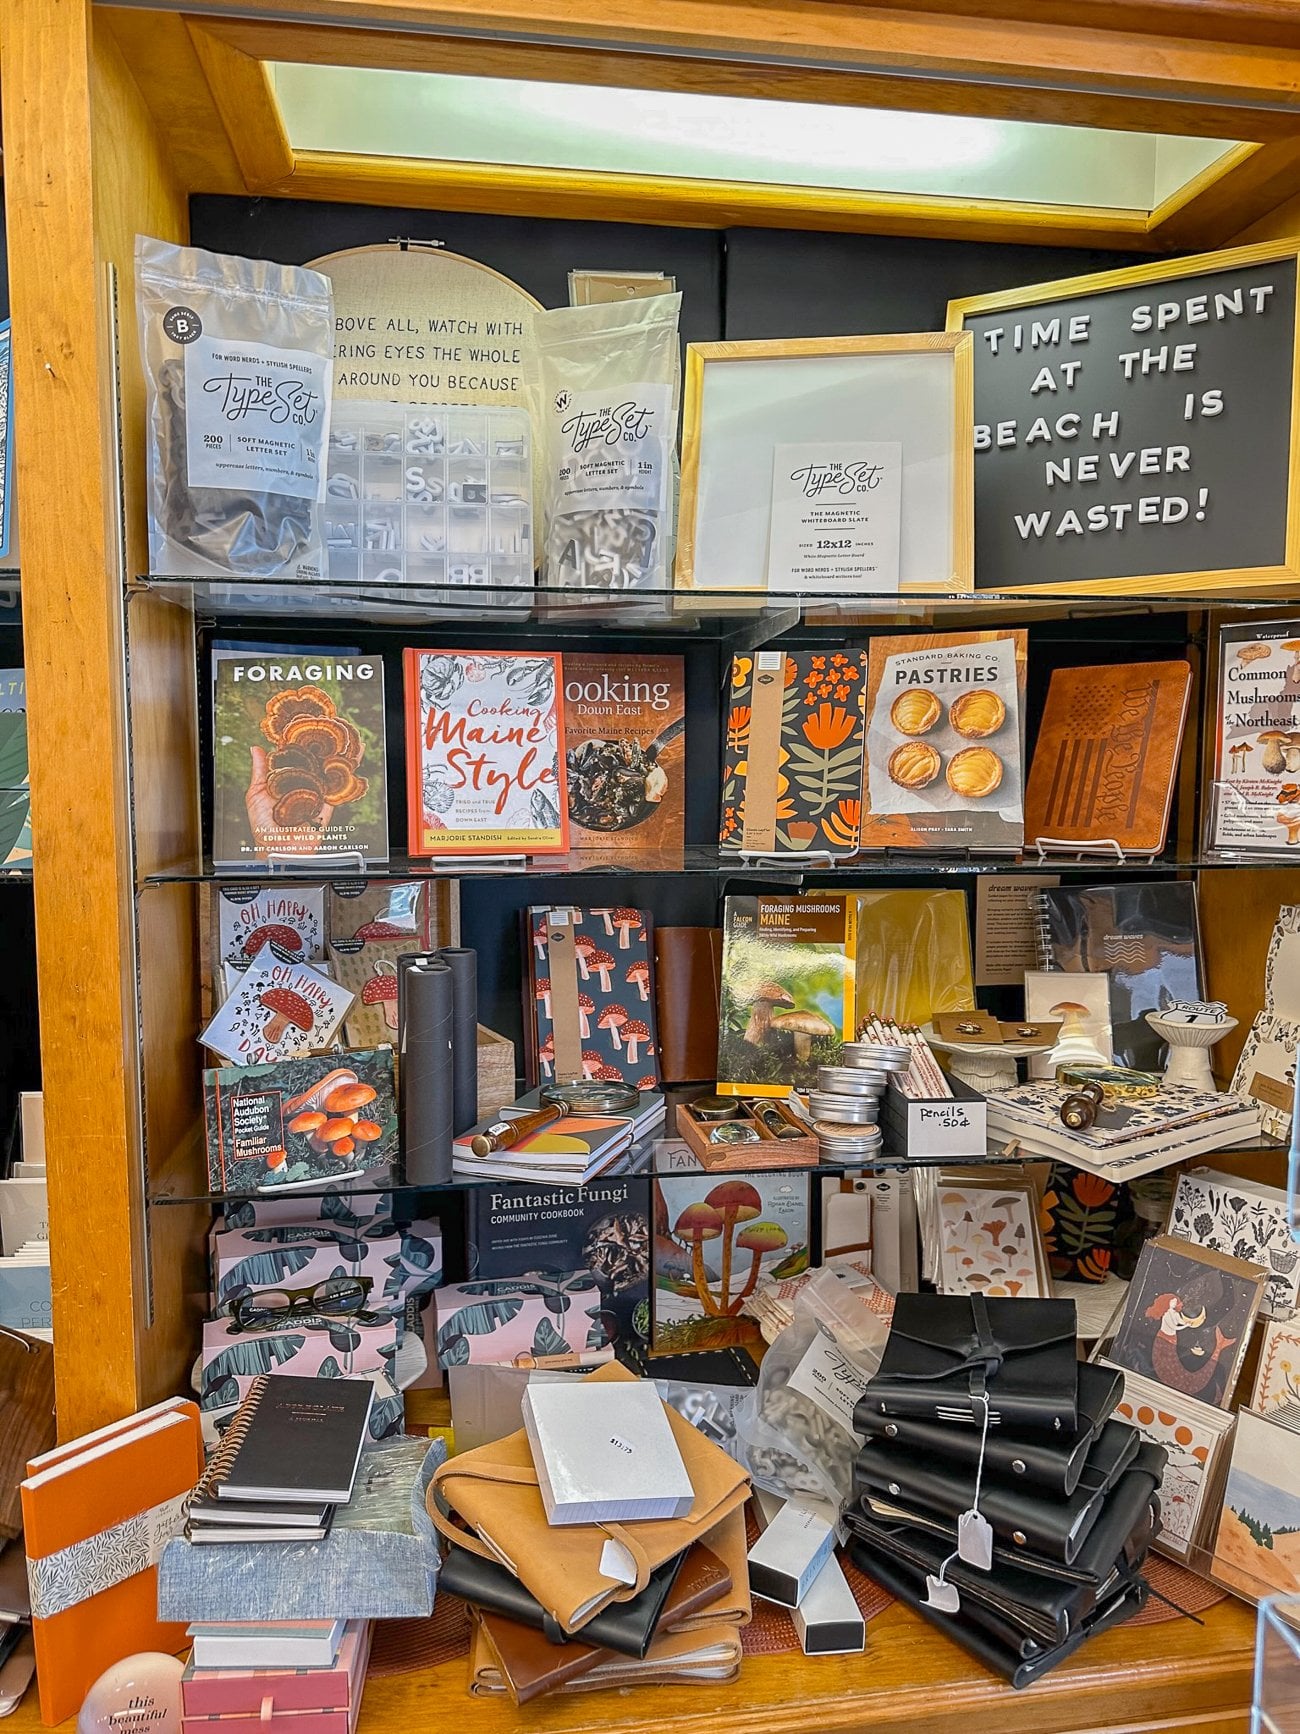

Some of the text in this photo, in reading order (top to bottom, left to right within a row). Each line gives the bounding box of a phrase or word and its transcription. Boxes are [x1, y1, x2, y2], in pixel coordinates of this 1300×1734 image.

[176, 320, 189, 333] B
[387, 318, 419, 334] ALL,
[429, 319, 478, 334] WATCH
[486, 322, 522, 336] WITH
[984, 286, 1274, 354] TIME SPENT
[384, 346, 425, 359] EYES
[433, 346, 462, 361] THE
[470, 350, 520, 364] WHOLE
[224, 354, 240, 362] WORD
[242, 356, 260, 364] NERDS
[266, 360, 288, 369] STYLISH
[289, 364, 312, 374] SPELLERS
[1030, 343, 1198, 394] AT THE
[255, 376, 272, 388] THE
[338, 372, 519, 390] AROUND YOU BECAUSE
[600, 407, 612, 418] THE
[974, 390, 1224, 450] BEACH IS
[203, 434, 223, 444] 200
[237, 436, 296, 450] SOFT MAGNETIC
[246, 446, 273, 455] LETTER
[580, 460, 625, 470] SOFT MAGNETIC
[1046, 445, 1190, 486] NEVER
[1014, 487, 1210, 539] WASTED!
[816, 540, 852, 549] 12x12
[896, 654, 942, 666] STANDARD
[233, 663, 374, 682] FORAGING
[896, 666, 998, 684] PASTRIES
[1228, 667, 1288, 682] Common
[565, 674, 670, 710] ooking
[1227, 688, 1300, 704] Mushrooms
[467, 698, 544, 721] Cooking
[578, 704, 642, 715] Down East
[1236, 710, 1298, 728] Northeast
[425, 706, 547, 750] Maine
[446, 746, 558, 815] Style
[269, 825, 317, 833] ILLUSTRATED
[241, 903, 260, 924] OH
[760, 904, 840, 914] FORAGING MUSHROOMS
[760, 914, 790, 926] MAINE
[272, 965, 292, 981] OH
[1182, 1005, 1218, 1014] ROUTE
[232, 1096, 265, 1108] National
[234, 1106, 270, 1116] Audubon
[235, 1136, 267, 1148] Familiar
[236, 1144, 282, 1157] Mushrooms
[490, 1184, 628, 1210] Fantastic Fungi
[490, 1208, 584, 1224] COMMUNITY COOKBOOK
[287, 1229, 330, 1238] CADDIS
[129, 1696, 154, 1708] this
[109, 1708, 168, 1726] beautiful
[120, 1726, 150, 1734] mess
